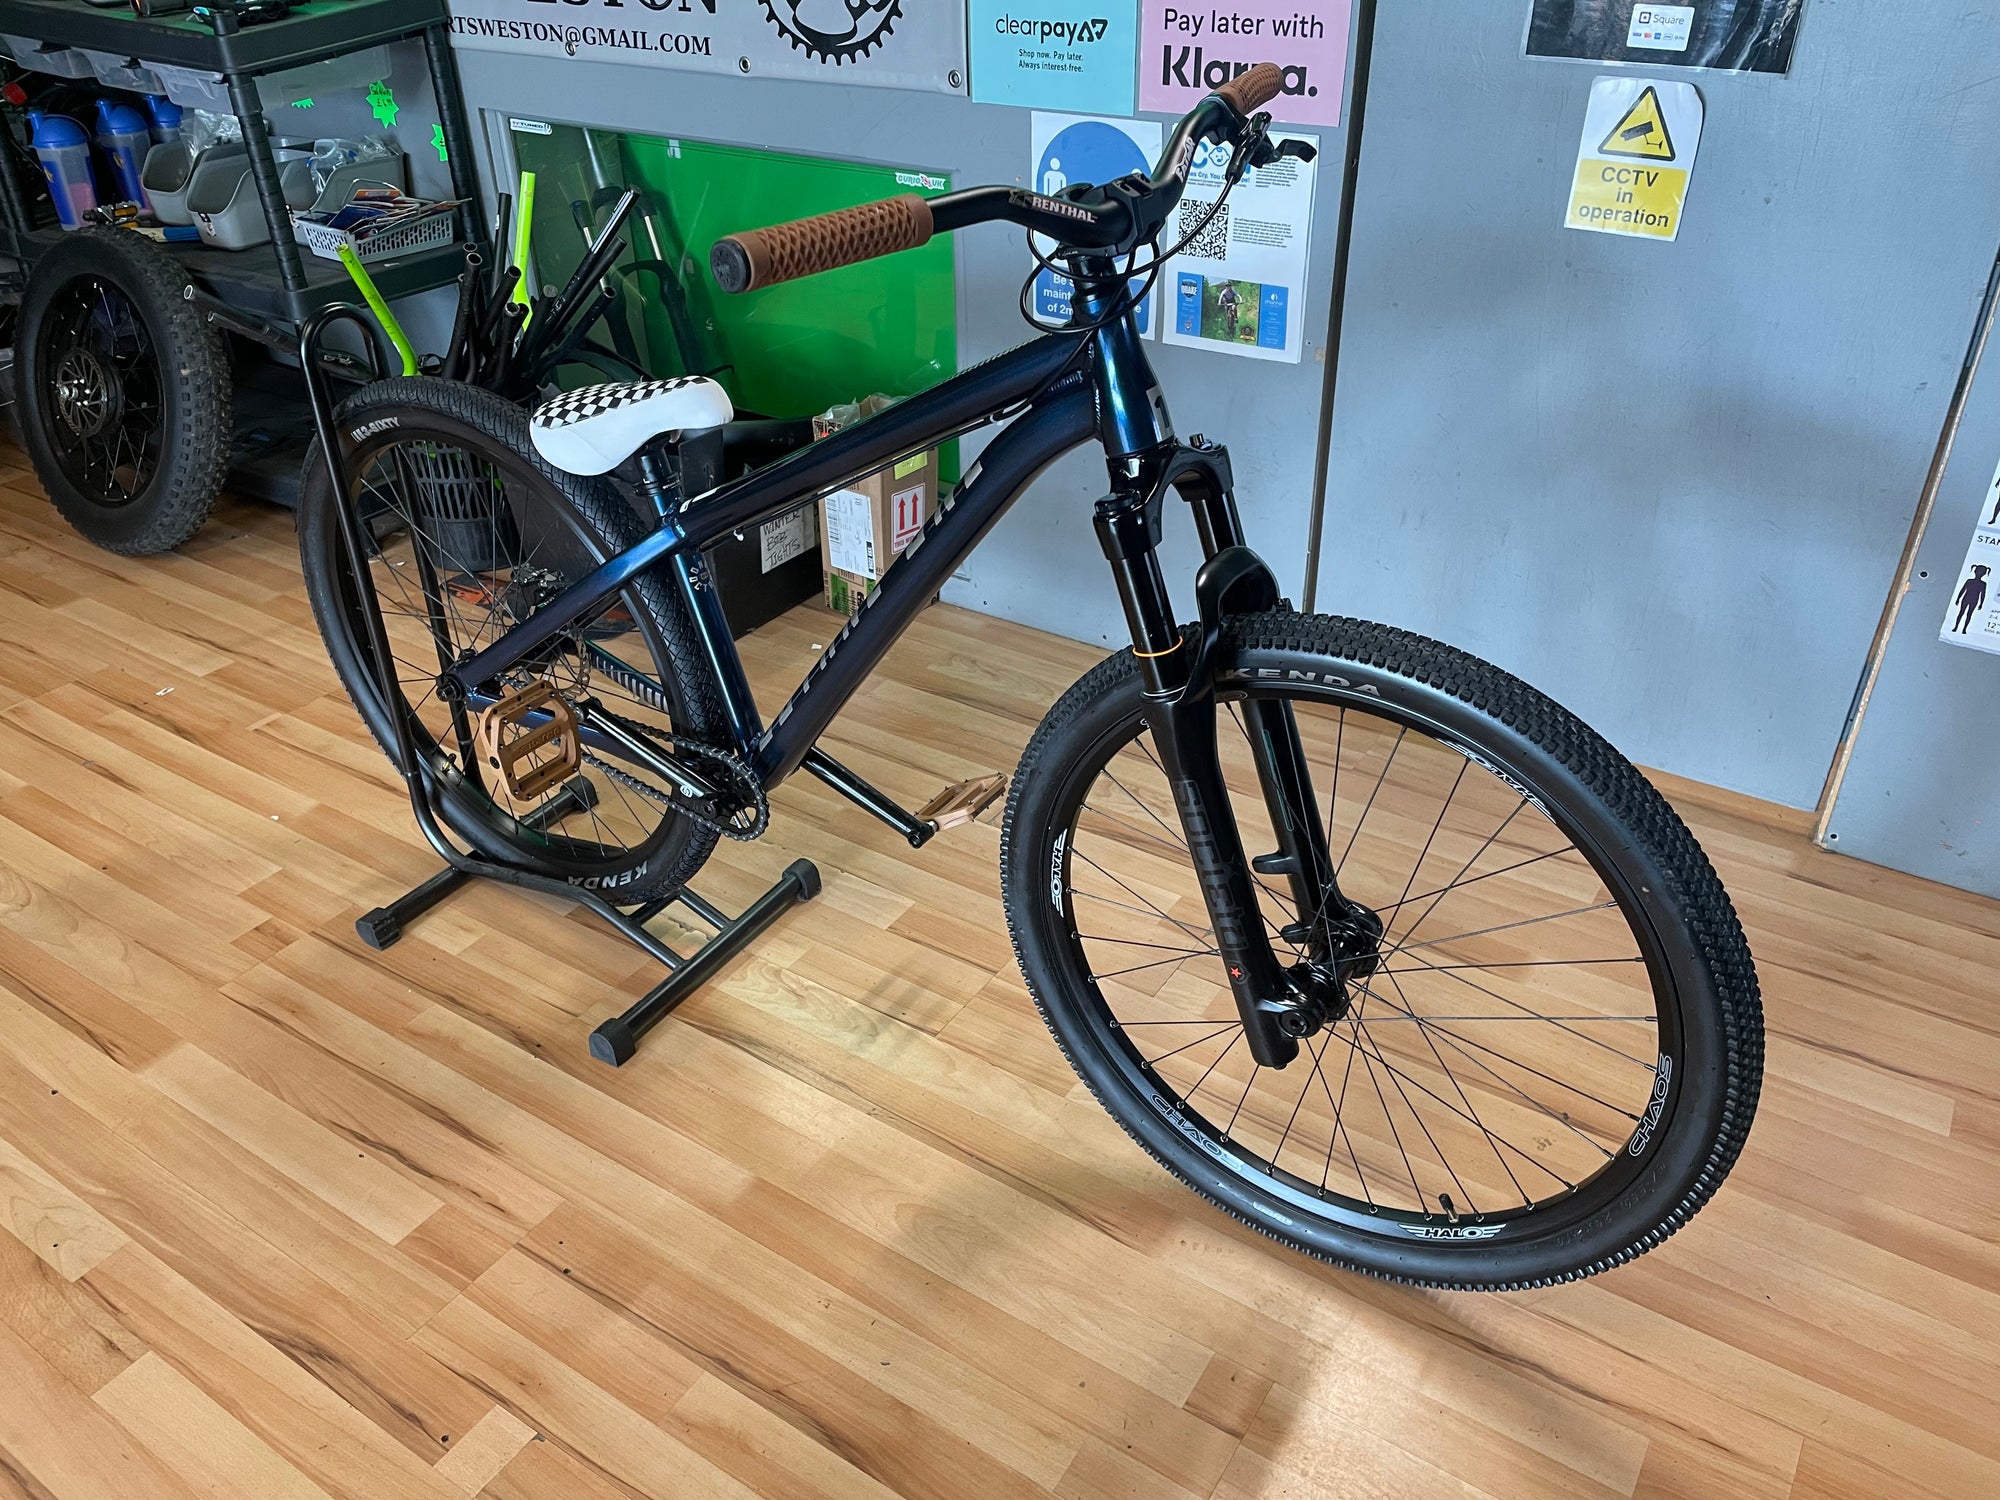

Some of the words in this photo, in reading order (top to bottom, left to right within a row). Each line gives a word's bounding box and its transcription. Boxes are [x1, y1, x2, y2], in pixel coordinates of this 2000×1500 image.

[996, 13, 1077, 46] clearpay
[1164, 8, 1204, 37] Pay
[1211, 10, 1265, 35] later
[1272, 13, 1324, 38] with
[1653, 14, 1685, 25] Square
[1019, 48, 1035, 59] Shop
[1053, 51, 1065, 61] Pay
[1067, 52, 1084, 61] later.
[1018, 60, 1040, 69] Always
[1041, 62, 1084, 73] interest-free.
[1162, 45, 1318, 97] Klara.
[1601, 166, 1659, 187] CCTV
[1616, 187, 1633, 204] in
[1031, 196, 1096, 224] RENTHAL
[1579, 205, 1669, 228] operation
[1053, 273, 1067, 286] Be
[1044, 288, 1071, 300] maint
[1047, 304, 1058, 314] of
[1224, 667, 1381, 697] KENDA
[567, 860, 649, 891] KENDA
[1628, 1054, 1673, 1158] CHAOS
